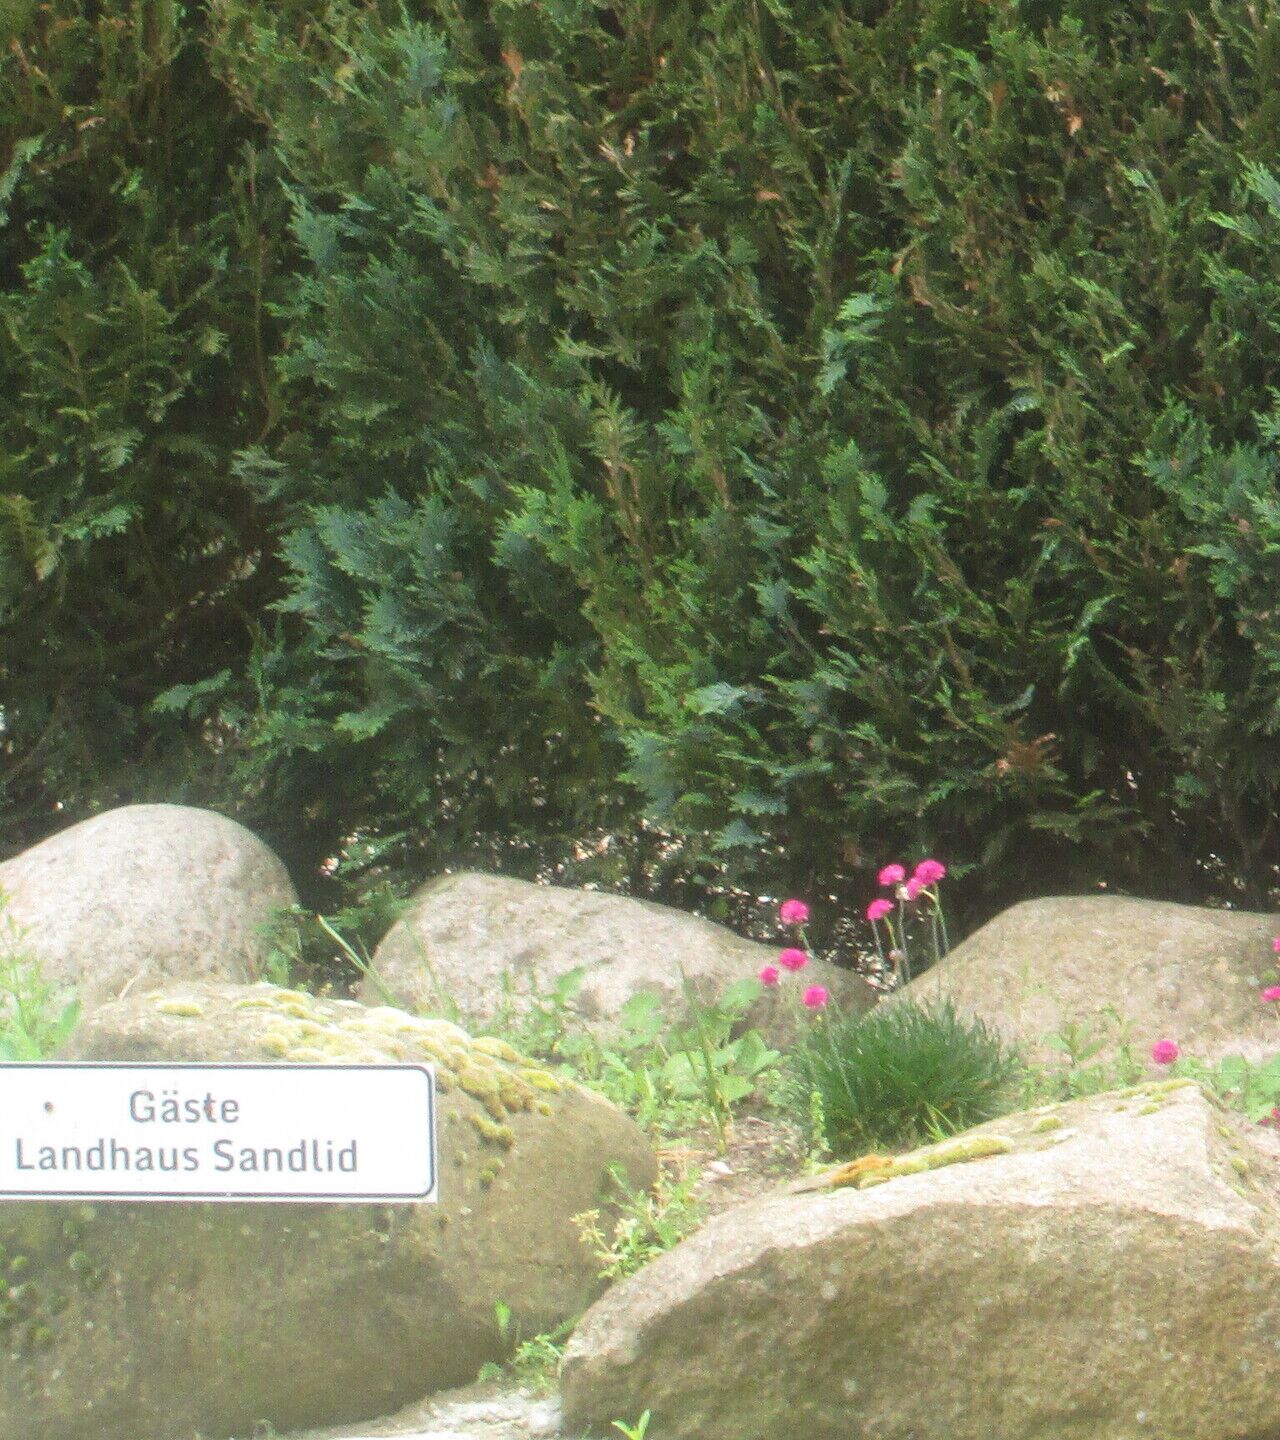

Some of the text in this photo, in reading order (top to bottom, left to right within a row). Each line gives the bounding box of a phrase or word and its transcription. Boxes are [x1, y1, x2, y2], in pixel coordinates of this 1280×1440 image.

[129, 1088, 240, 1124] Gäste
[15, 1138, 358, 1173] Landhaus Sandlid
